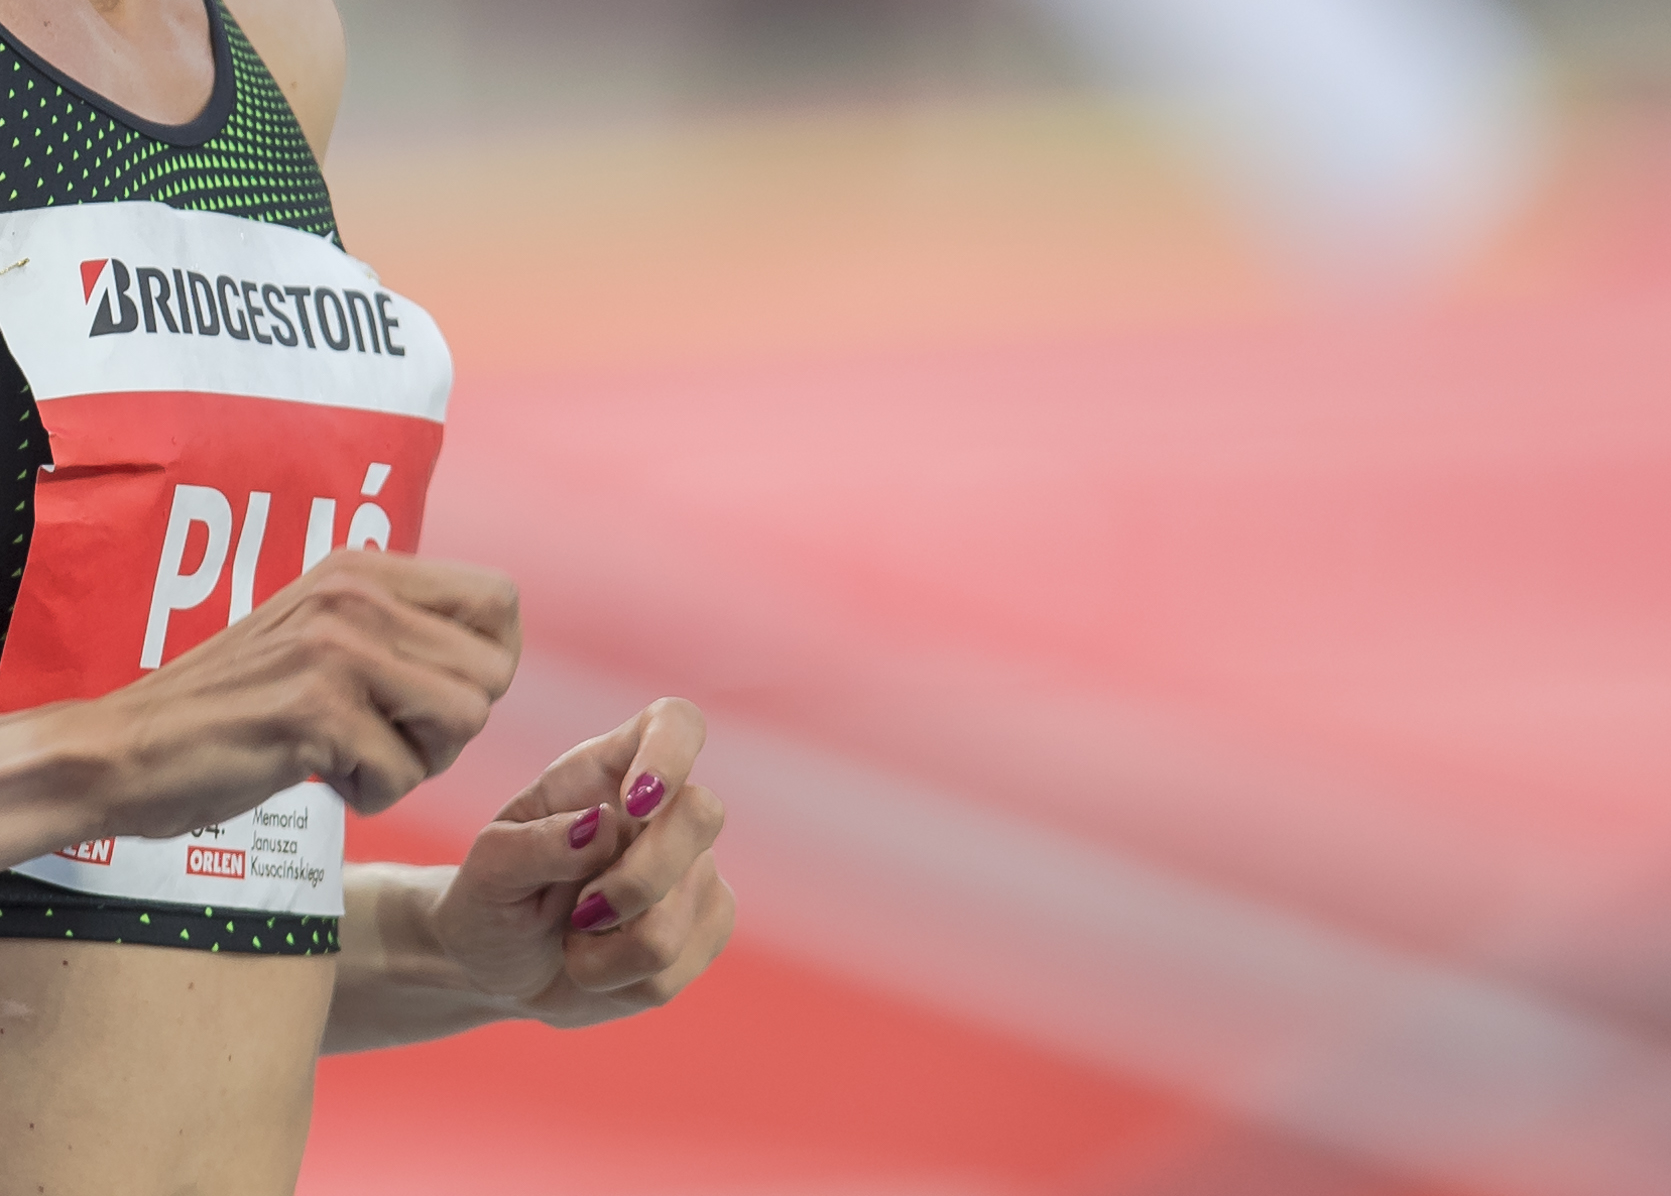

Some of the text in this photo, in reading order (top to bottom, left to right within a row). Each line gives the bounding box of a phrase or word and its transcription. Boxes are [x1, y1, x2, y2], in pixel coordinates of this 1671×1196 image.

[80, 257, 406, 356] BRIDGESTONE
[252, 806, 308, 829] Memoriał
[251, 830, 298, 854] Janusza
[190, 849, 243, 875] ORLEN
[250, 855, 325, 888] Kusocińskiego
